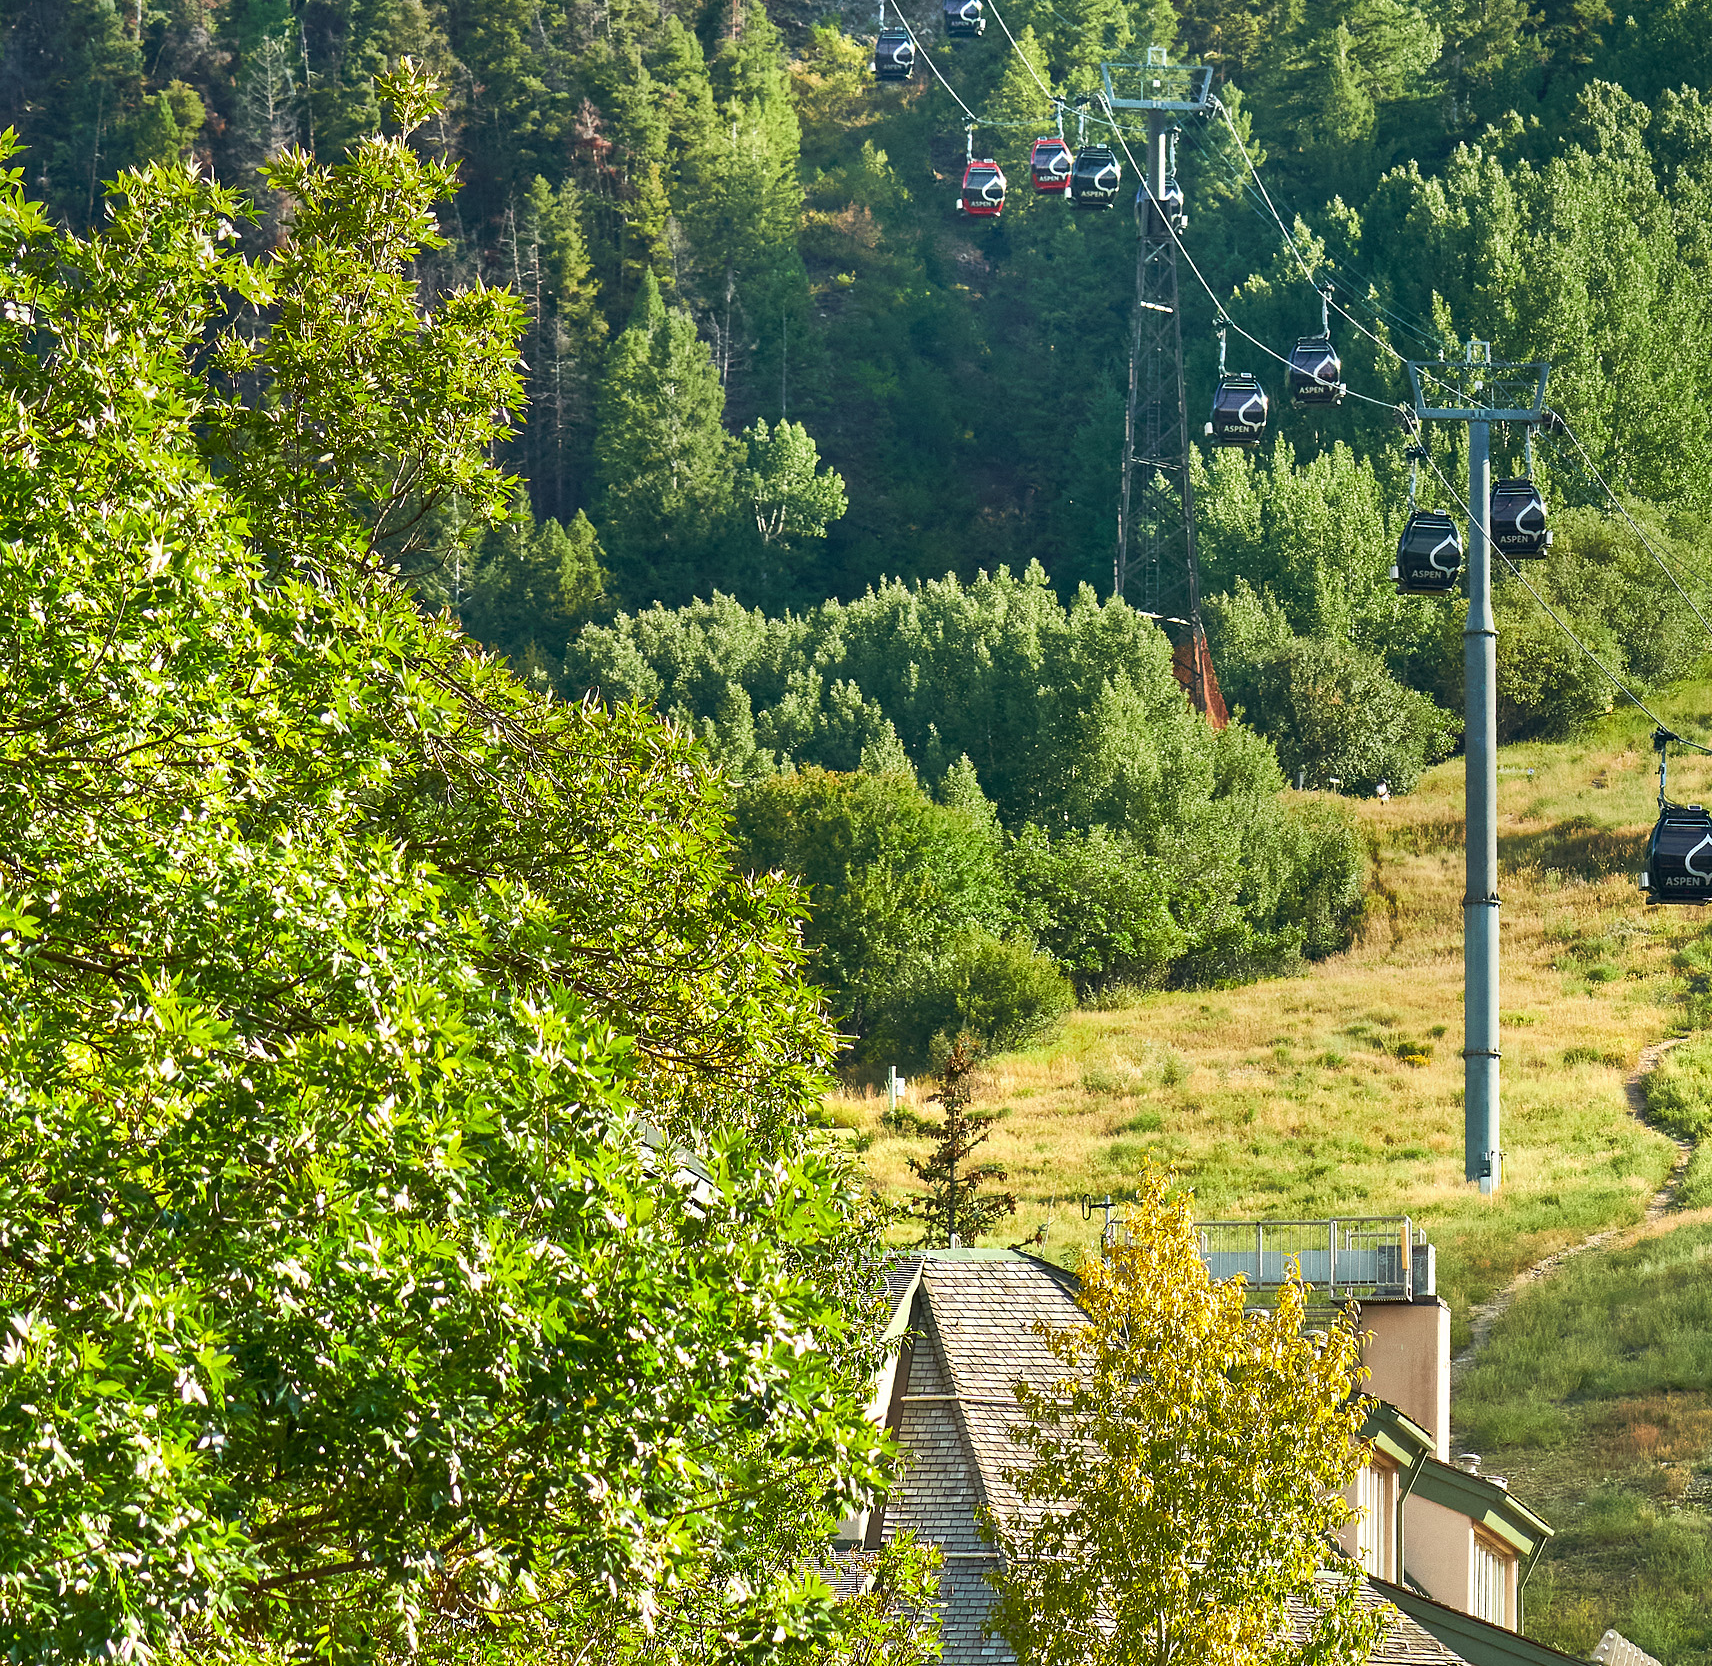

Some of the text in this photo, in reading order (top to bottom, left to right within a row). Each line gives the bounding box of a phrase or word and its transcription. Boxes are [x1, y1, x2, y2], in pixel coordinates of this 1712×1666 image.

[1500, 535, 1528, 543] ASPEN
[1412, 570, 1441, 578] ASPEN
[1666, 877, 1700, 886] ASPEN
